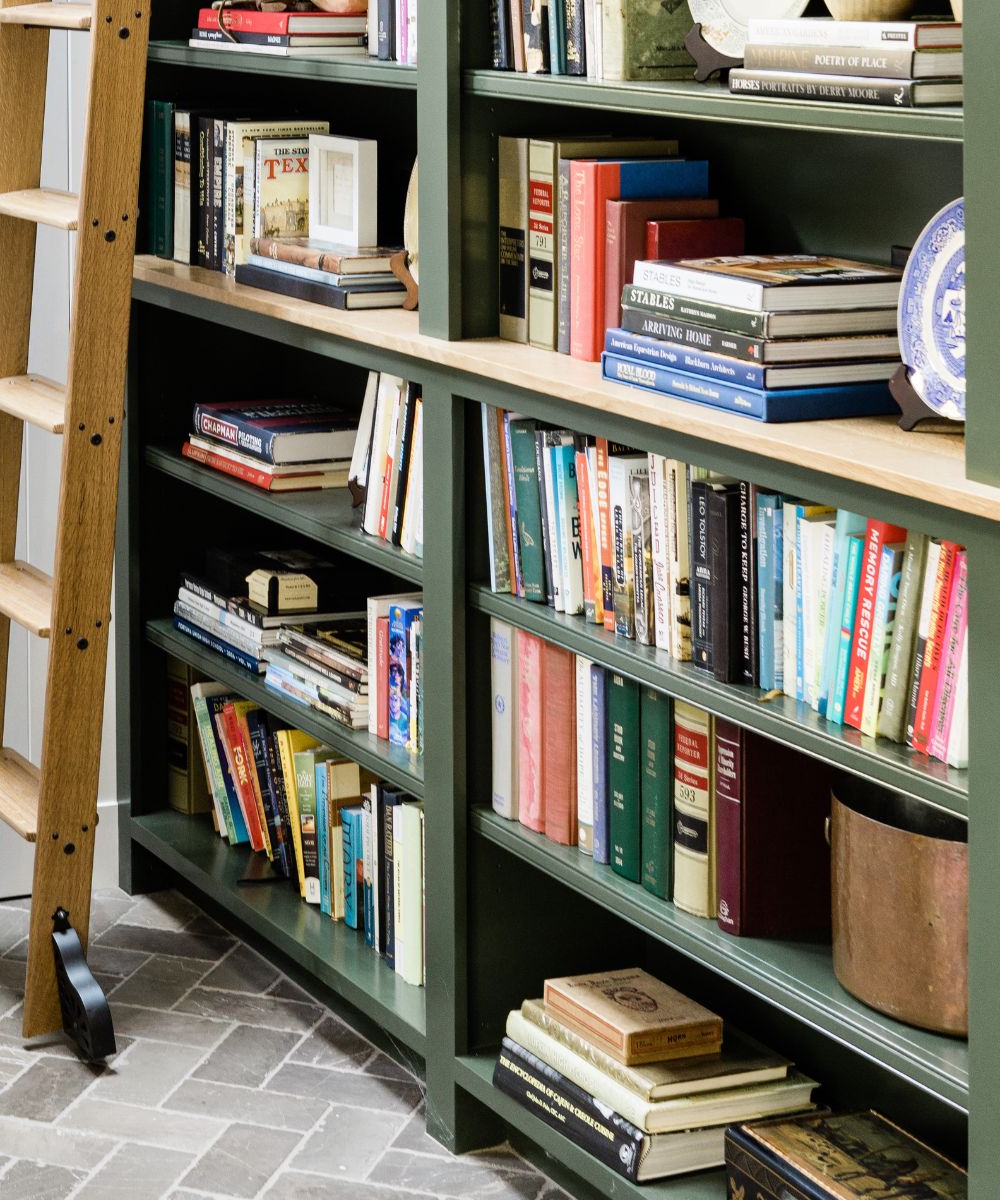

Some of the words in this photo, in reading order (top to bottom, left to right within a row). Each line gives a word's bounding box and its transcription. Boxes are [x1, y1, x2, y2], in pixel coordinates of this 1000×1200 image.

[815, 54, 845, 66] POETRY
[848, 56, 860, 66] OF
[861, 57, 887, 69] PLACE
[732, 78, 760, 91] HORSES
[761, 81, 805, 94] PORTRAITS
[806, 84, 817, 95] BY
[819, 86, 846, 97] DERRY
[848, 88, 879, 99] MOORE
[274, 148, 290, 156] THE
[214, 156, 222, 208] EMPIRE
[264, 158, 309, 180] TEX
[575, 170, 585, 194] The
[532, 197, 550, 208] REPORTER
[533, 188, 549, 198] FEDERAL
[574, 199, 585, 230] Lone
[535, 235, 547, 248] 791
[573, 235, 584, 261] Star
[643, 270, 681, 288] STABLES
[630, 289, 675, 310] STABLES
[681, 307, 699, 316] KATHRYN
[642, 319, 683, 340] ARRIVING
[685, 329, 712, 346] HOME
[611, 338, 633, 350] American
[634, 342, 659, 358] Equestrian
[660, 348, 677, 362] Design
[617, 363, 635, 376] ROYAL
[636, 367, 656, 380] BLOOD
[685, 356, 709, 369] Blackburn
[711, 362, 735, 375] Architects
[203, 417, 236, 441] CHAPMAN
[238, 431, 262, 446] PILOTING
[598, 471, 608, 508] EDGE
[651, 454, 661, 554] JUICED
[739, 482, 748, 530] CHARGE
[599, 511, 608, 548] EFFECT
[740, 532, 748, 549] TO
[759, 506, 767, 567] Investigation
[654, 560, 664, 581] Jose
[740, 551, 748, 581] KEEP
[863, 528, 880, 596] MEMORY
[878, 552, 891, 601] DARING
[902, 581, 910, 597] Your
[655, 582, 666, 624] Canseco
[932, 579, 943, 609] Powerful
[856, 597, 872, 661] RESCUE
[872, 604, 886, 655] GREATLY
[928, 611, 940, 638] Healing
[951, 604, 964, 632] Cure
[895, 624, 904, 642] Kelly
[949, 635, 961, 656] for
[913, 653, 923, 679] Hilary
[924, 640, 936, 667] Secrets
[852, 666, 862, 692] AMEN
[945, 658, 958, 679] All
[910, 680, 920, 707] Mantel
[937, 680, 956, 735] Diseases
[677, 743, 700, 760] REPORTER
[678, 733, 698, 748] FEDERAL
[233, 746, 248, 785] FORK
[684, 773, 698, 785] Series
[680, 785, 696, 803] 593
[385, 805, 393, 824] DAN
[385, 825, 393, 857] RATHER
[500, 1056, 510, 1071] THE
[510, 1061, 546, 1094] ENCYCLOPEDIA
[546, 1085, 553, 1098] OF
[553, 1089, 569, 1111] CAJUN
[574, 1105, 595, 1129] CREOLE
[595, 1120, 614, 1142] CUISINE
